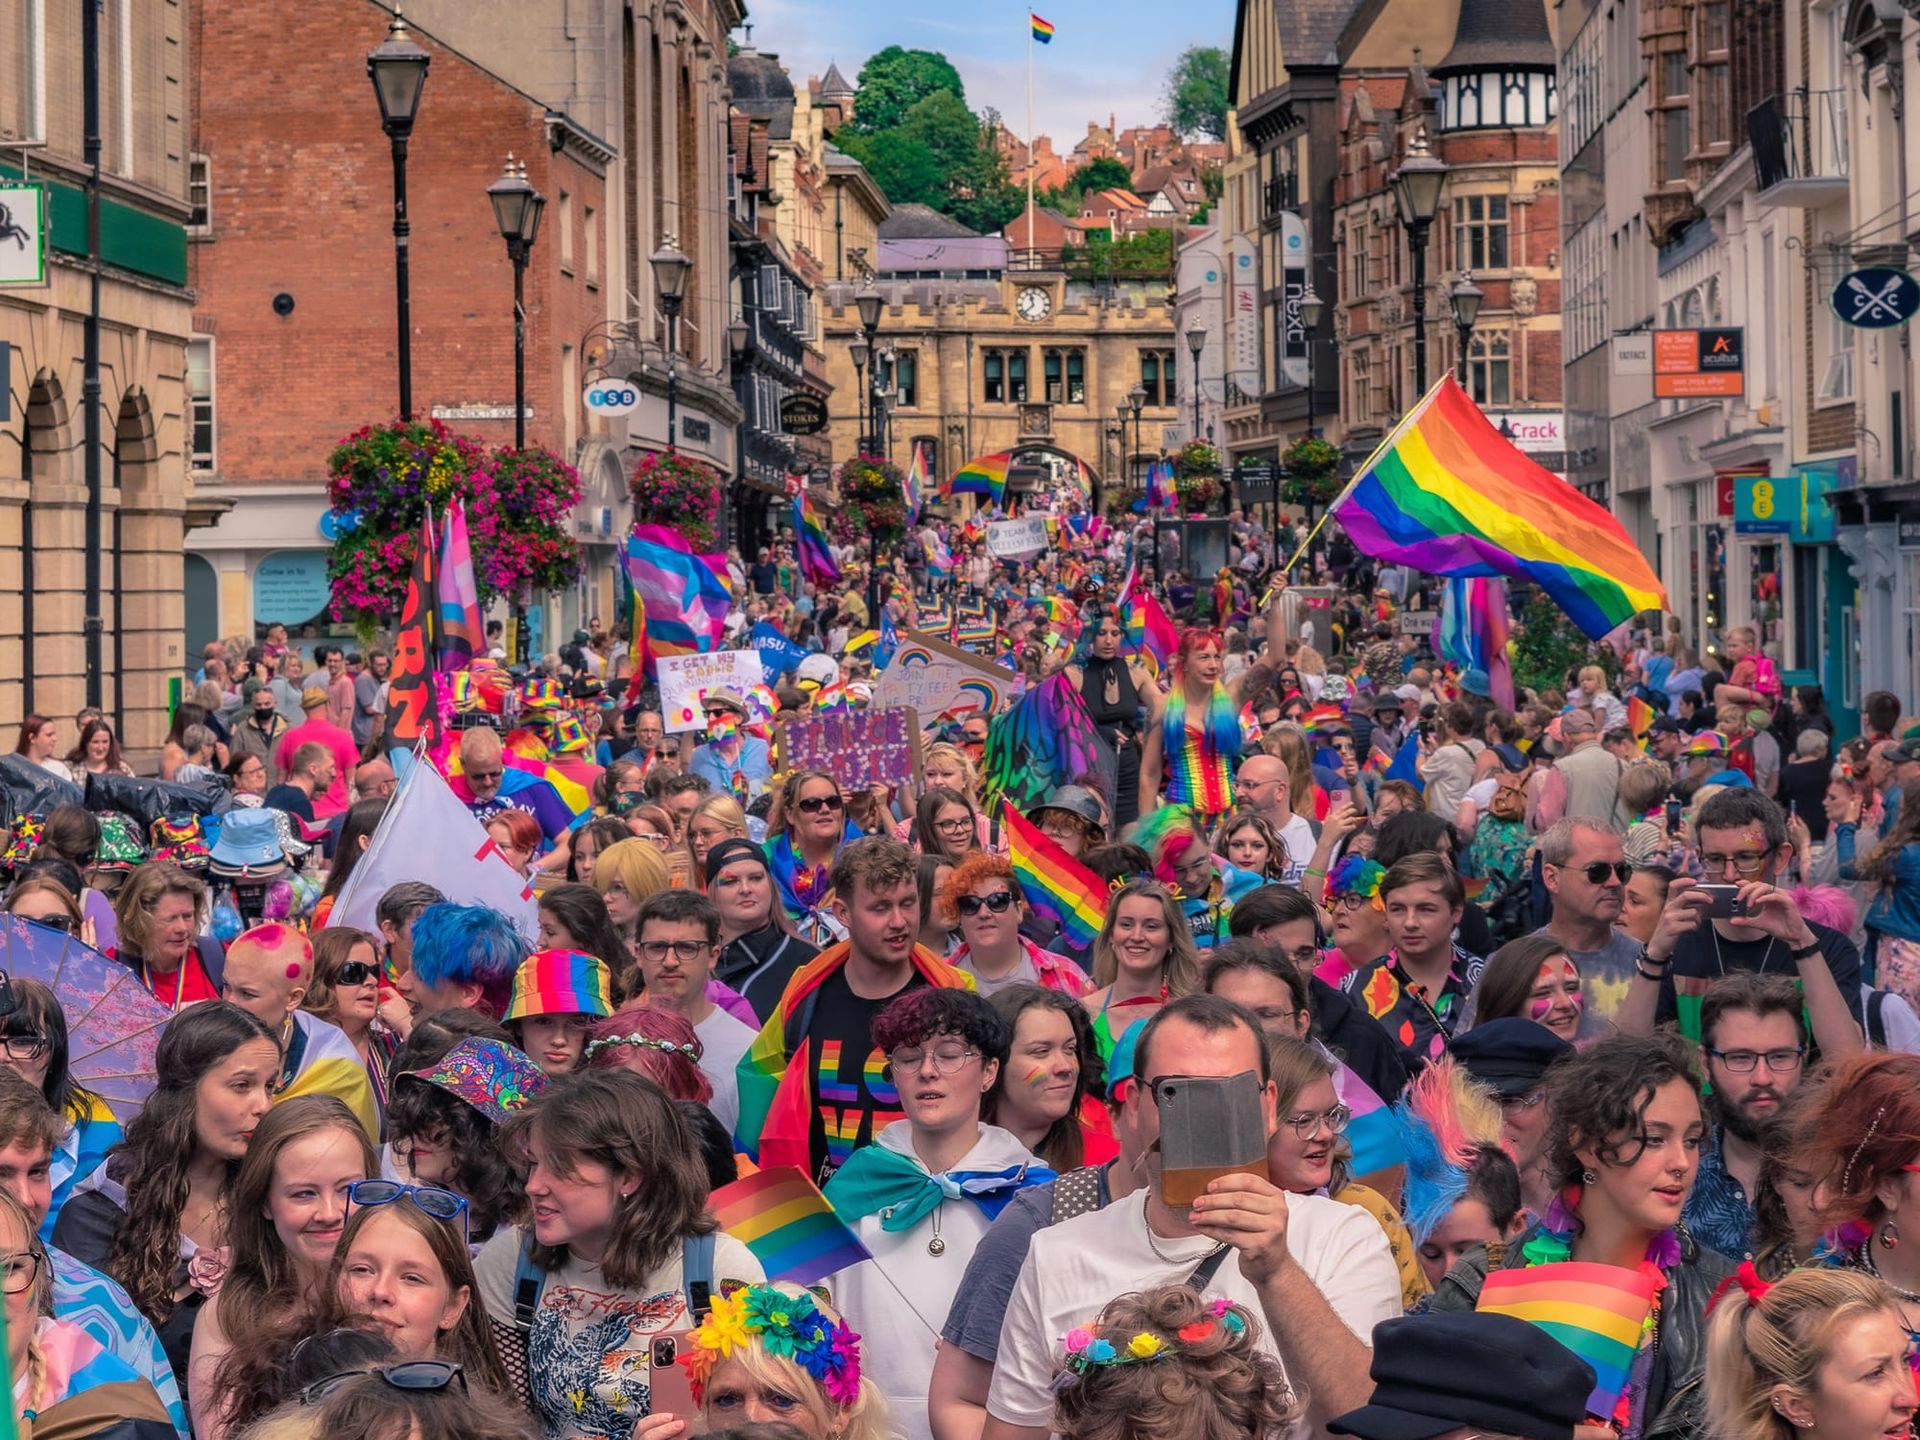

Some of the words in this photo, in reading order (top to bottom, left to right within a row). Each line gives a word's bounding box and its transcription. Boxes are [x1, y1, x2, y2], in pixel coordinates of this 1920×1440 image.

[1286, 283, 1305, 342] next
[1675, 334, 1694, 343] Sale
[592, 391, 632, 407] TSB
[782, 414, 820, 423] STOKES
[1166, 430, 1181, 440] W
[1511, 421, 1558, 438] Crack
[1003, 527, 1026, 537] TEAM
[260, 567, 284, 576] Come
[287, 567, 296, 576] in
[297, 568, 306, 576] to
[683, 655, 709, 669] GET
[717, 652, 736, 664] MY
[897, 667, 925, 681] JOIN
